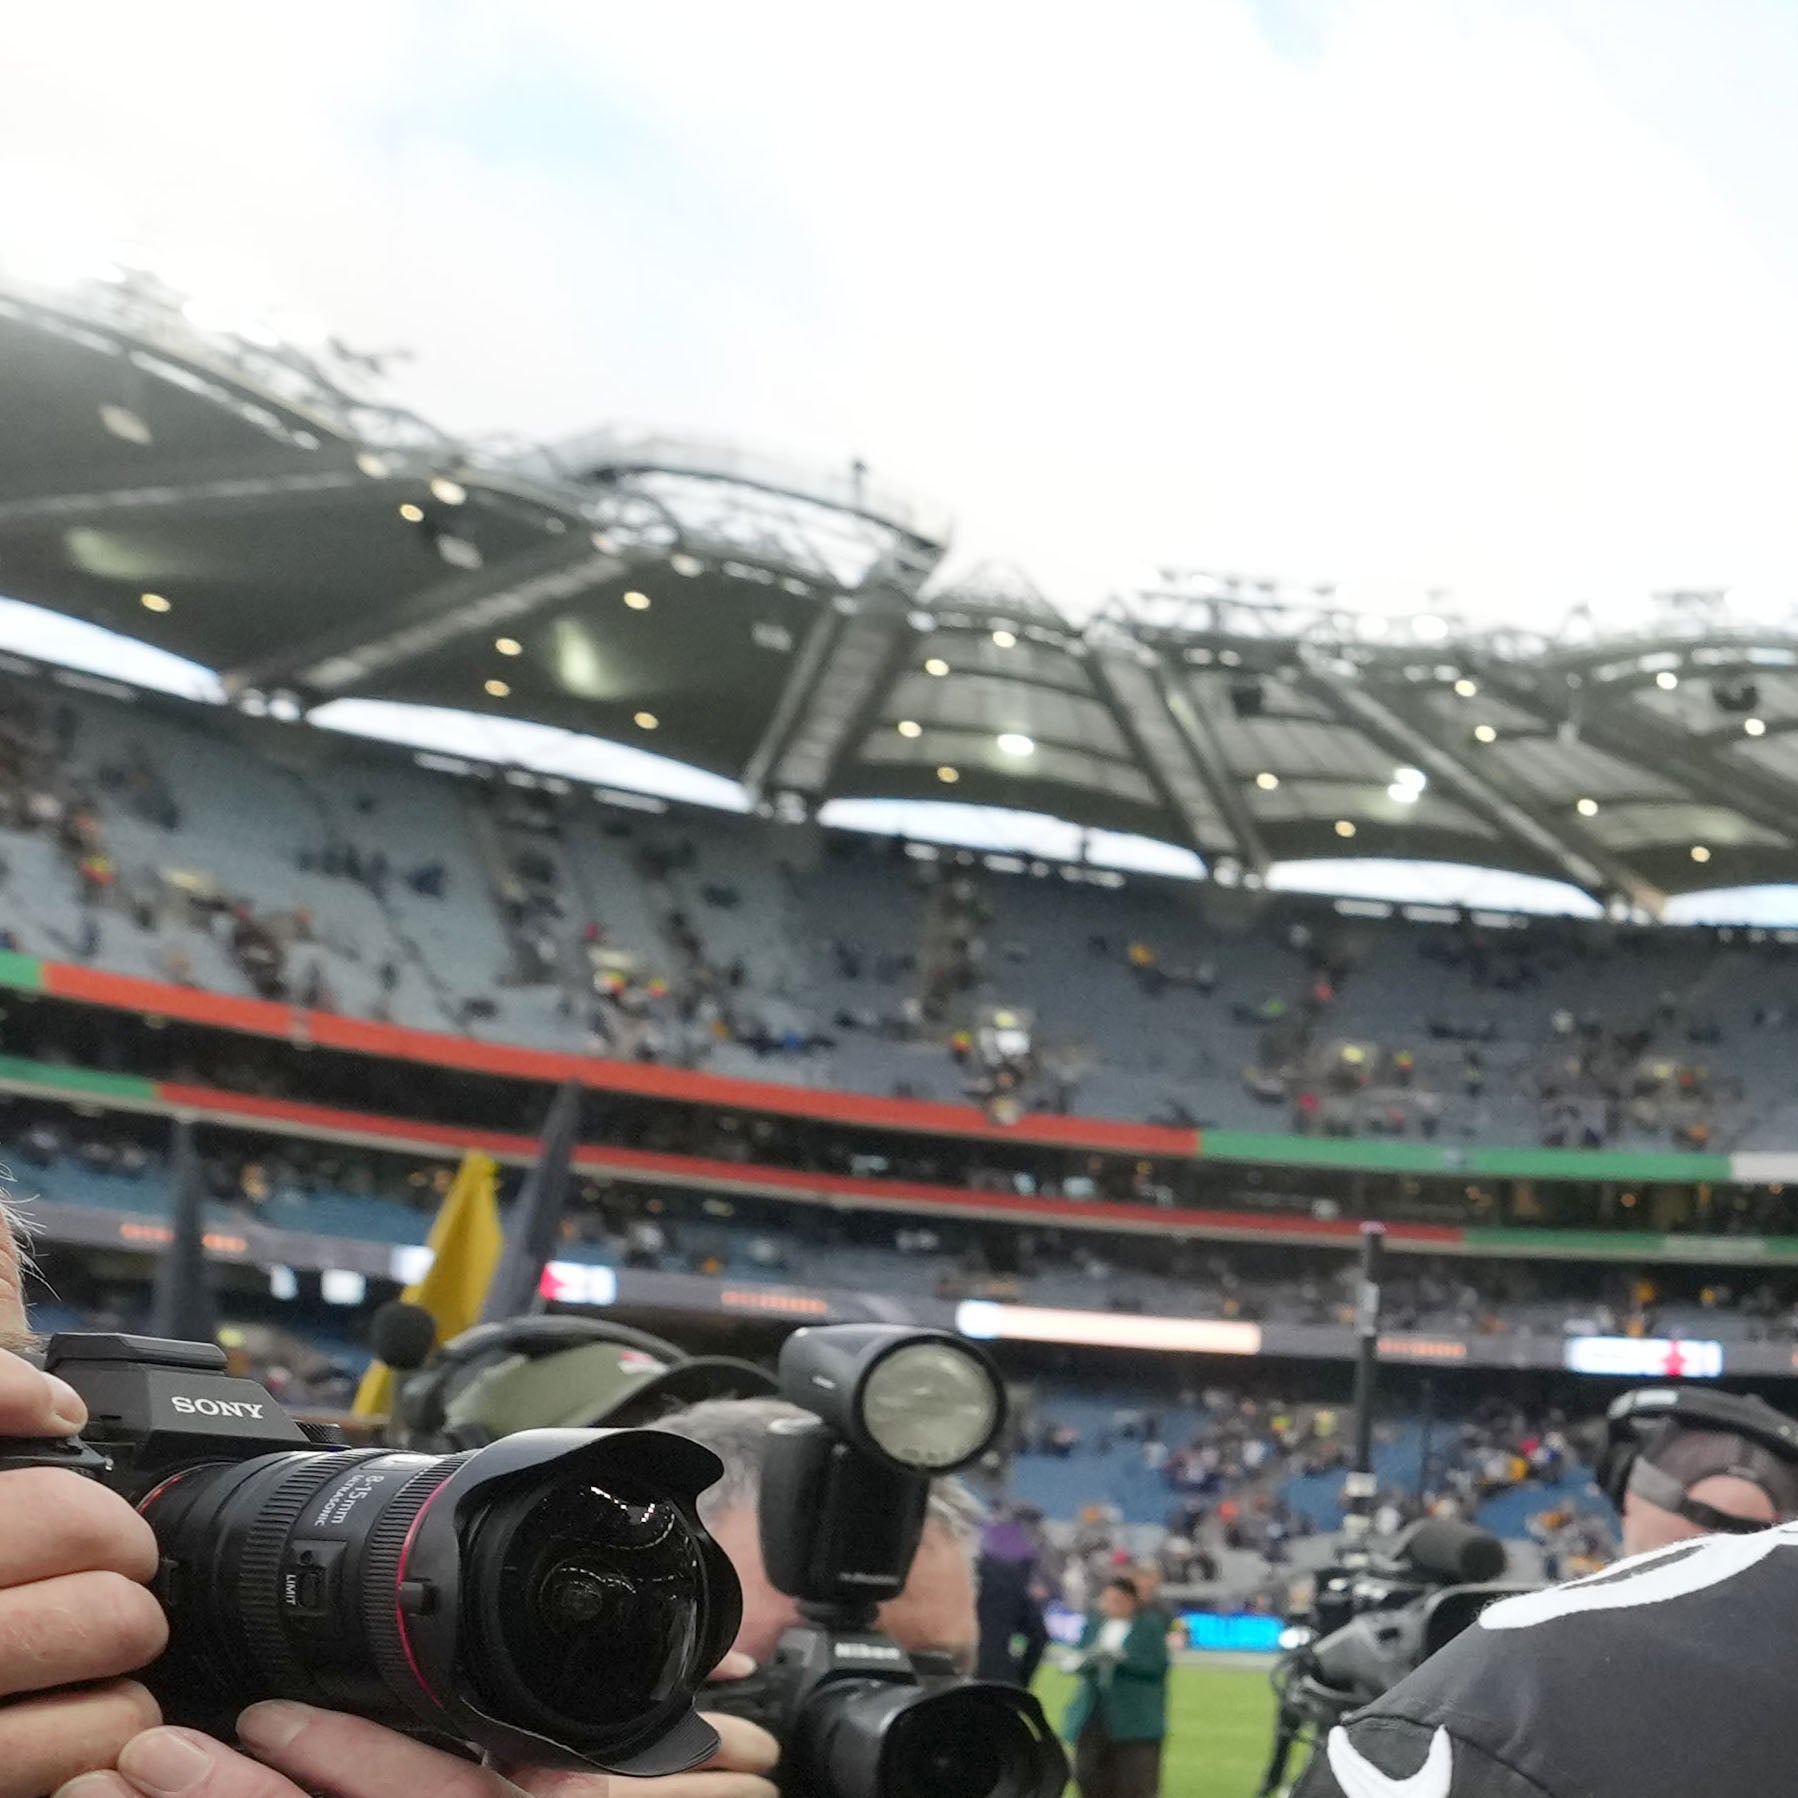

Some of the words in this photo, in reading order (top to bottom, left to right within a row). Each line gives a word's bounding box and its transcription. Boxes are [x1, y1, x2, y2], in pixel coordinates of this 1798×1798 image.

[171, 1396, 264, 1419] SONY
[314, 1474, 364, 1527] ULTRASONIC
[331, 1475, 385, 1524] 8-15mm
[285, 1574, 297, 1606] LIMIT
